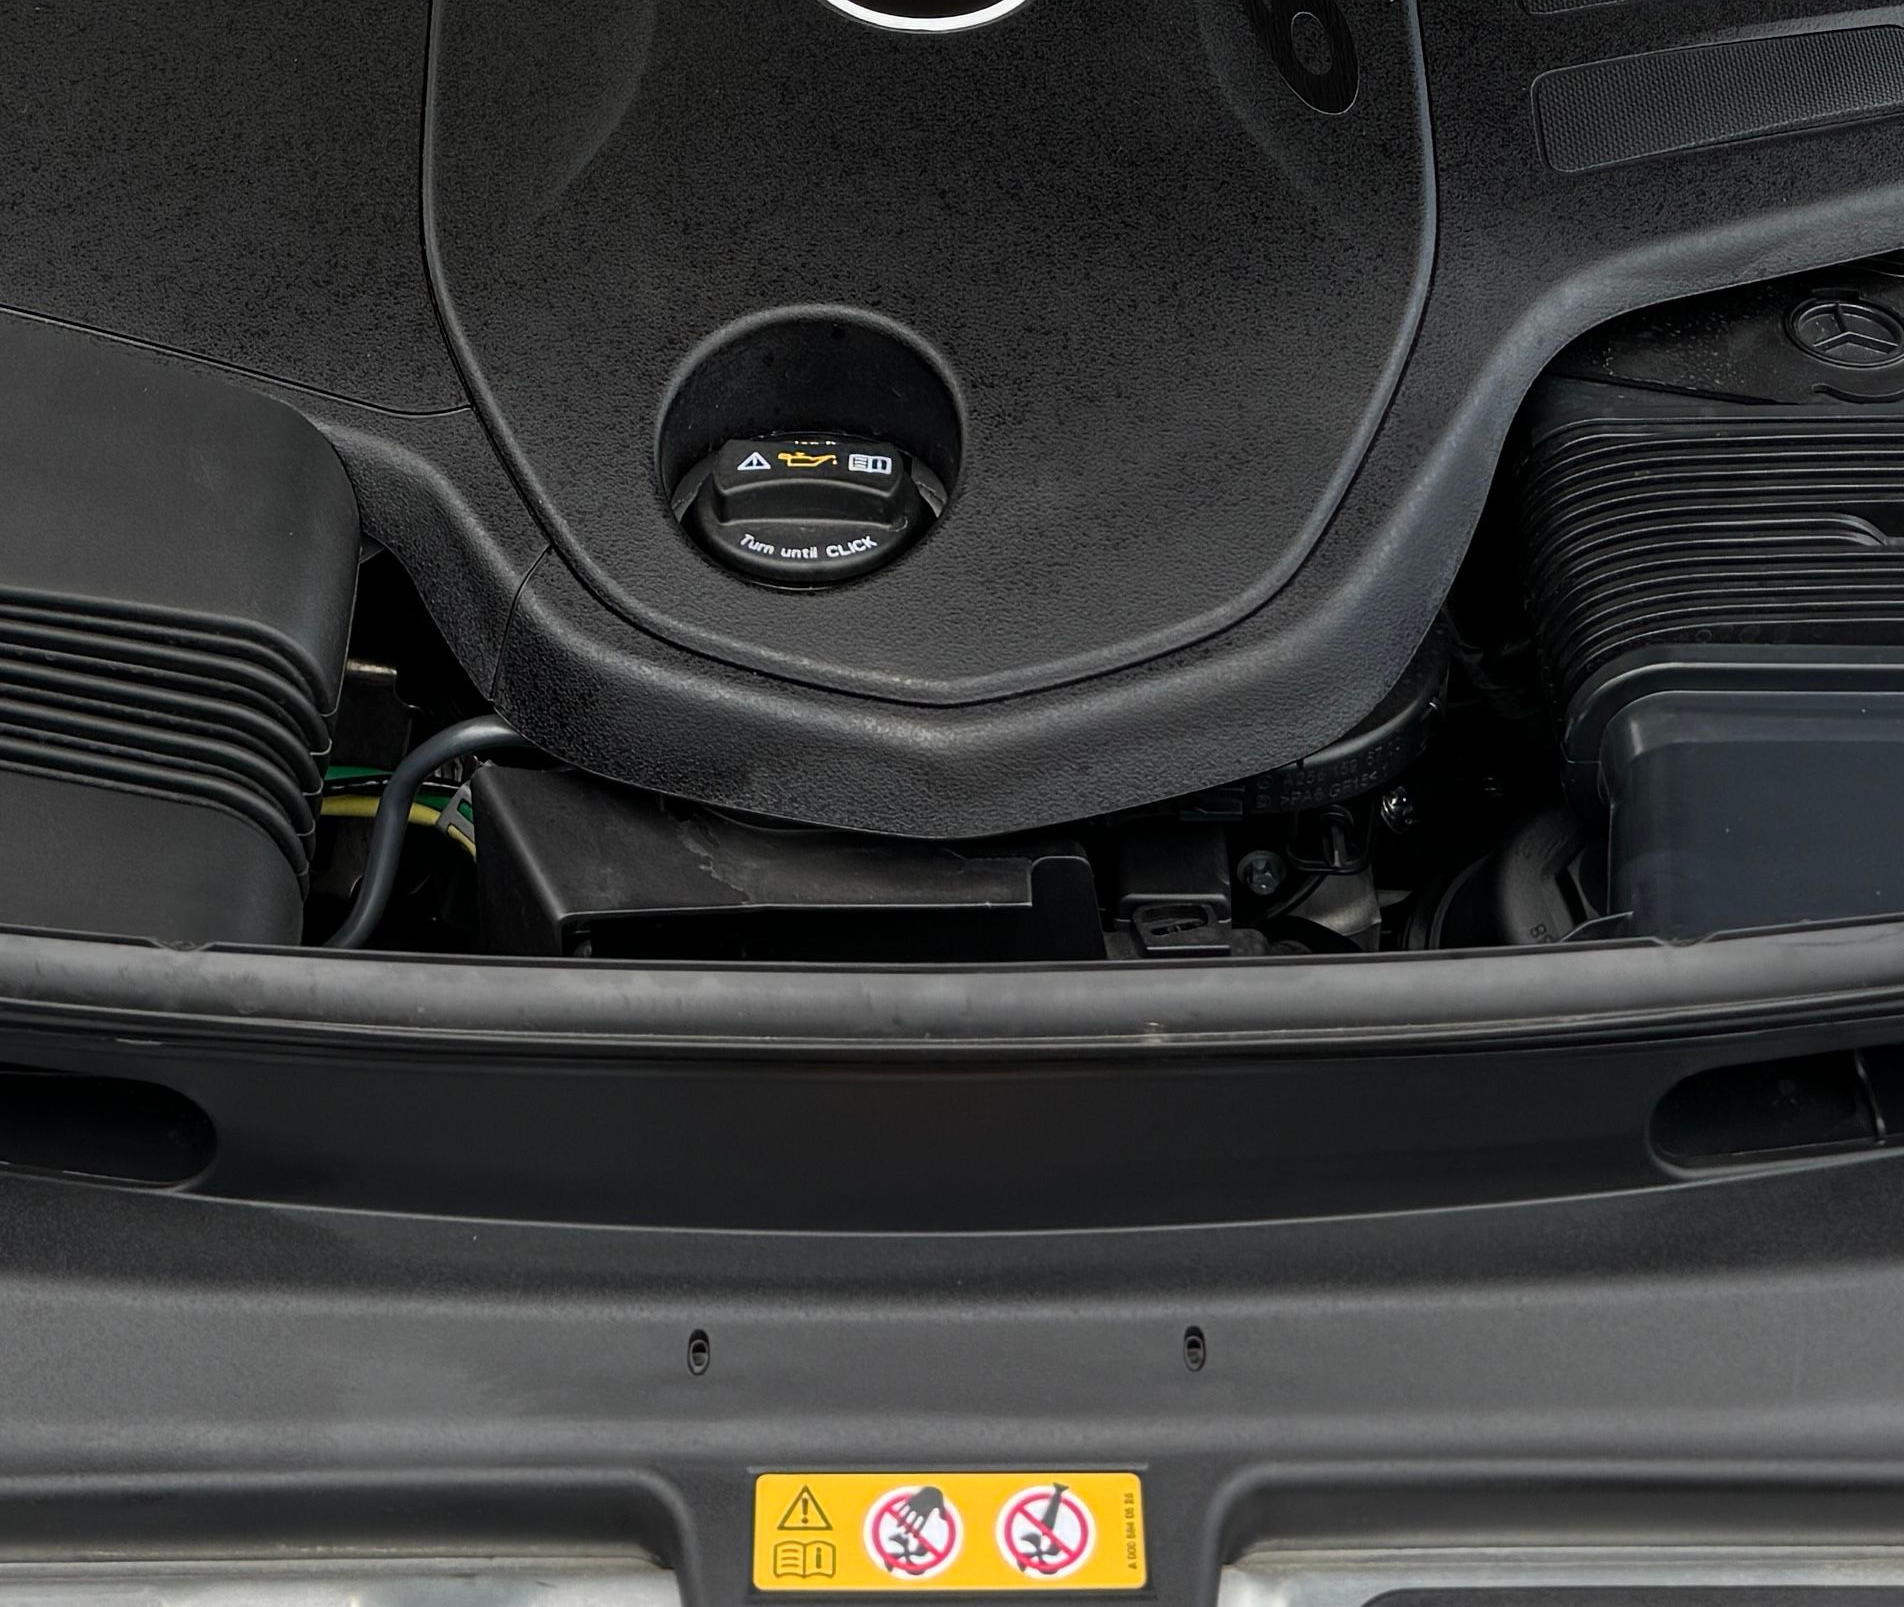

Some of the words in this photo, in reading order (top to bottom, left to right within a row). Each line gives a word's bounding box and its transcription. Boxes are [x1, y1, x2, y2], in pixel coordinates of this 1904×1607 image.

[739, 533, 775, 557] Turn
[781, 545, 818, 559] until
[825, 534, 879, 559] CLICK
